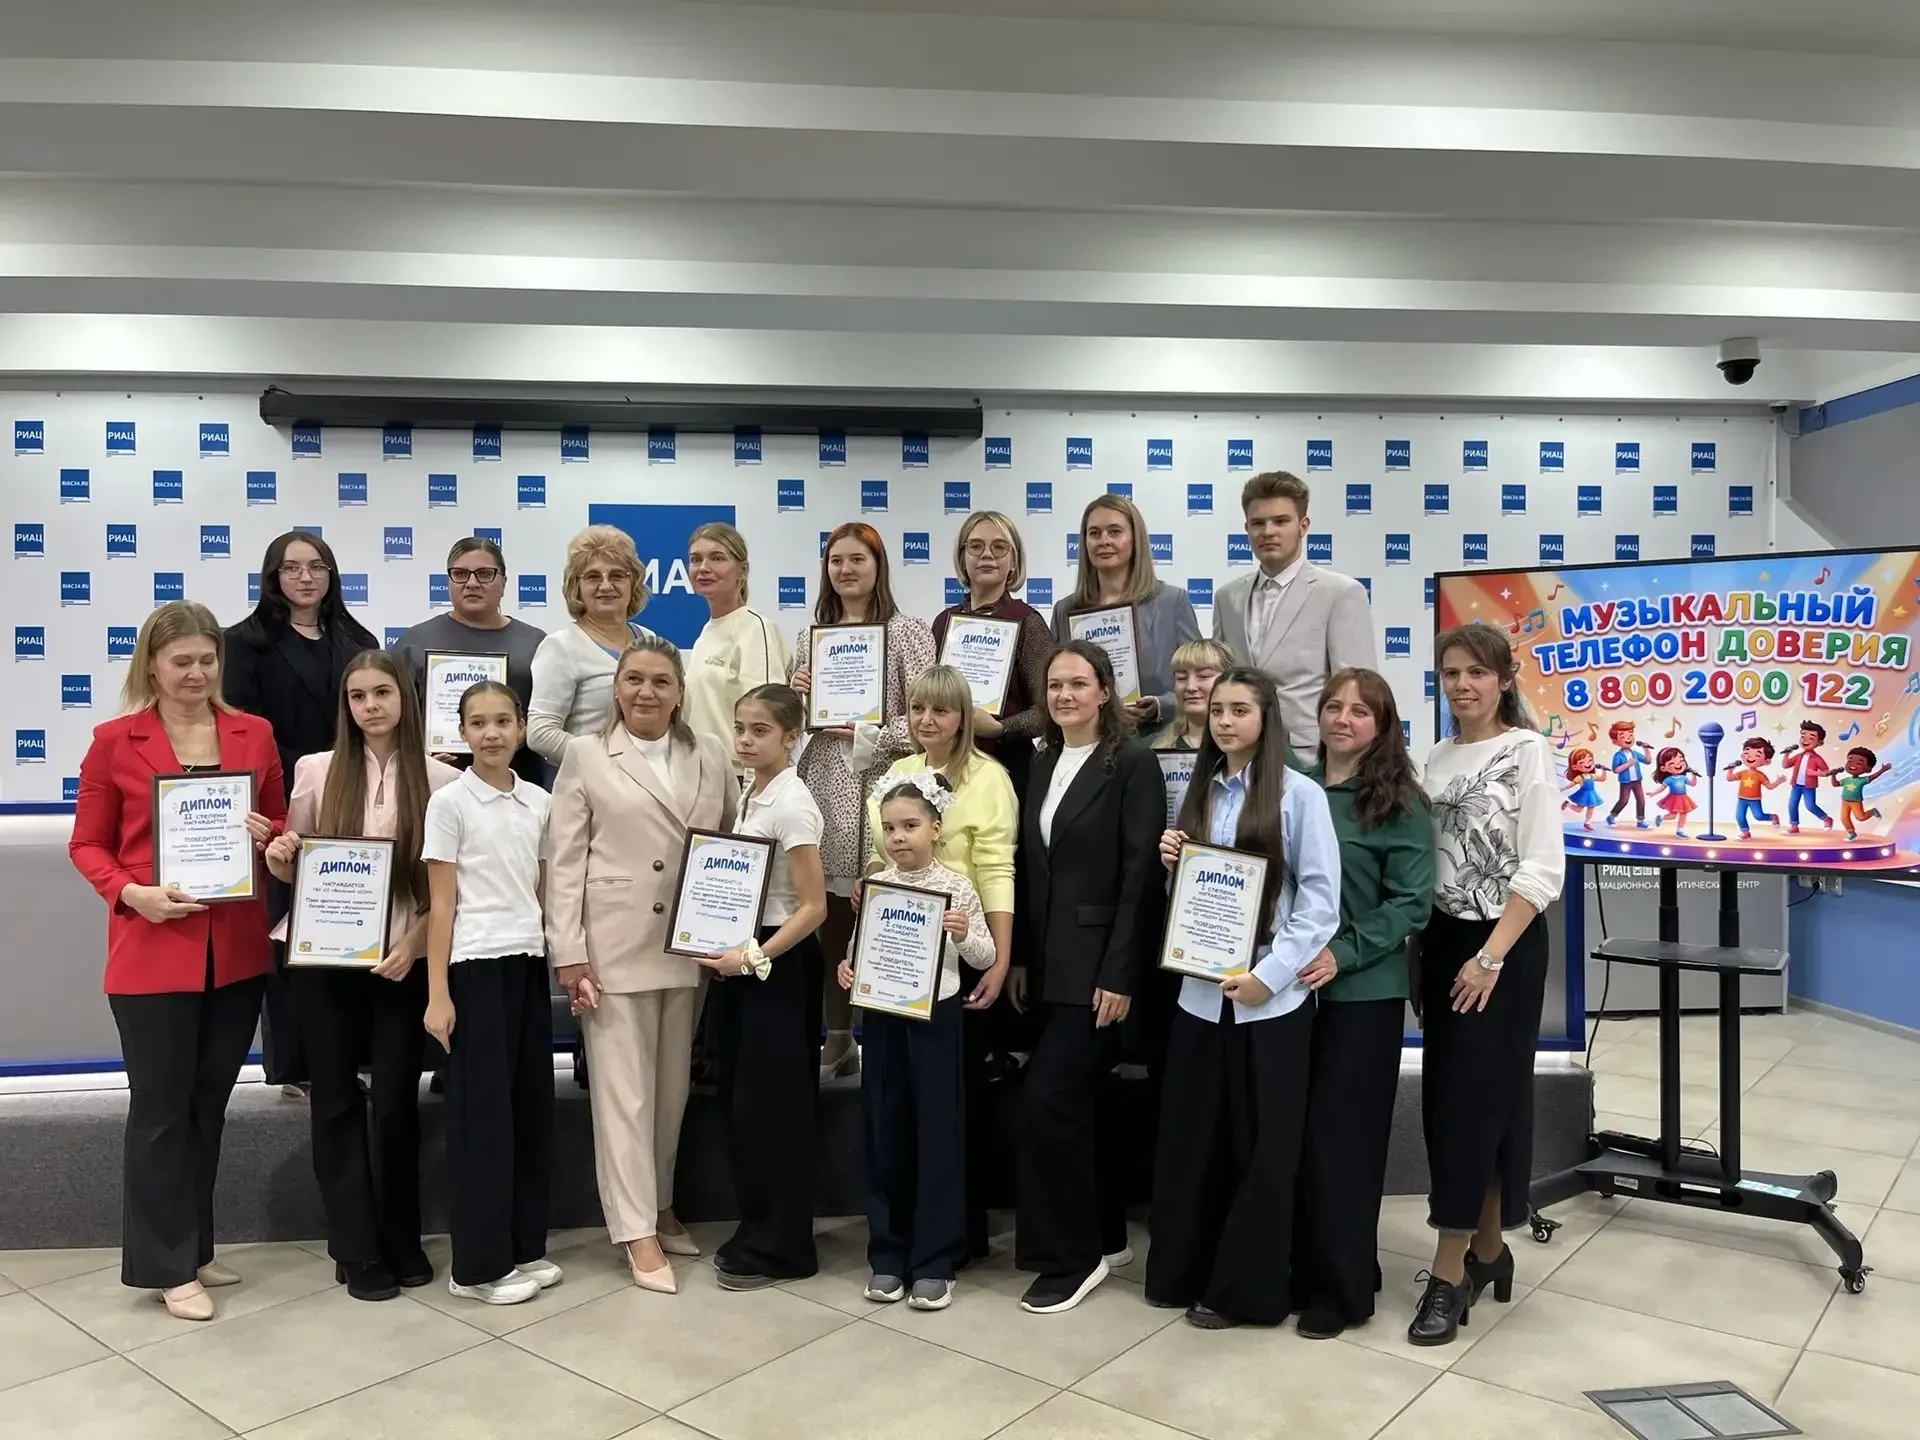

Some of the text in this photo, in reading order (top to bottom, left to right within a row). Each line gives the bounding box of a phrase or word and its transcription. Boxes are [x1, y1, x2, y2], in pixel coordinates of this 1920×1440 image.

[16, 430, 43, 440] РИАЦ
[108, 432, 135, 441] РИАЦ
[201, 433, 228, 442] РИАЦ
[294, 434, 320, 444] РИАЦ
[385, 436, 411, 445] РИАЦ
[475, 438, 500, 447] РИАЦ
[563, 439, 586, 448] РИАЦ
[650, 442, 674, 450] РИАЦ
[736, 442, 760, 451] РИАЦ
[821, 444, 845, 453] РИАЦ
[904, 446, 928, 454] РИАЦ
[986, 446, 1010, 455] РИАЦ
[1068, 446, 1091, 456] РИАЦ
[1150, 448, 1171, 456] РИАЦ
[1230, 448, 1252, 457] РИАЦ
[1308, 449, 1331, 458] РИАЦ
[1388, 449, 1409, 458] РИАЦ
[1464, 449, 1487, 458] РИАЦ
[1542, 450, 1563, 459] РИАЦ
[1616, 451, 1639, 460] РИАЦ
[1692, 452, 1715, 460] РИАЦ
[16, 533, 43, 543] РИАЦ
[108, 534, 136, 544] РИАЦ
[202, 535, 227, 543] РИАЦ
[386, 536, 412, 546] РИАЦ
[904, 542, 929, 551] РИАЦ
[1308, 543, 1331, 552] РИАЦ
[1386, 543, 1409, 551] РИАЦ
[1464, 543, 1487, 551] РИАЦ
[1540, 543, 1563, 552] РИАЦ
[1616, 544, 1638, 552] РИАЦ
[1692, 544, 1714, 552] РИАЦ
[1561, 585, 1876, 636] МУЗЫКАЛЬНЫЙ
[1085, 625, 1121, 640] ДИПЛОМ
[17, 636, 44, 646] РИАЦ
[109, 637, 136, 646] РИАЦ
[961, 634, 1001, 647] ДИПЛОМ
[1386, 636, 1409, 644] РИАЦ
[829, 644, 868, 657] ДИПЛОМ
[1533, 628, 1909, 673] ТЕЛЕФОН ДОВЕРИЯ
[444, 673, 488, 684] ДИПЛОМ
[1565, 670, 1872, 708] 8 800 2000 122
[18, 739, 45, 749] РИАЦ
[179, 798, 232, 815] ДИПЛОМ
[319, 861, 371, 876] ДИПЛОМ
[704, 857, 750, 874] ДИПЛОМ
[1602, 864, 1630, 878] РИАЦ
[1196, 870, 1245, 890] ДИПЛОМ
[1737, 881, 1760, 889] ЕНТР
[881, 908, 926, 926] ДИПЛОМ
